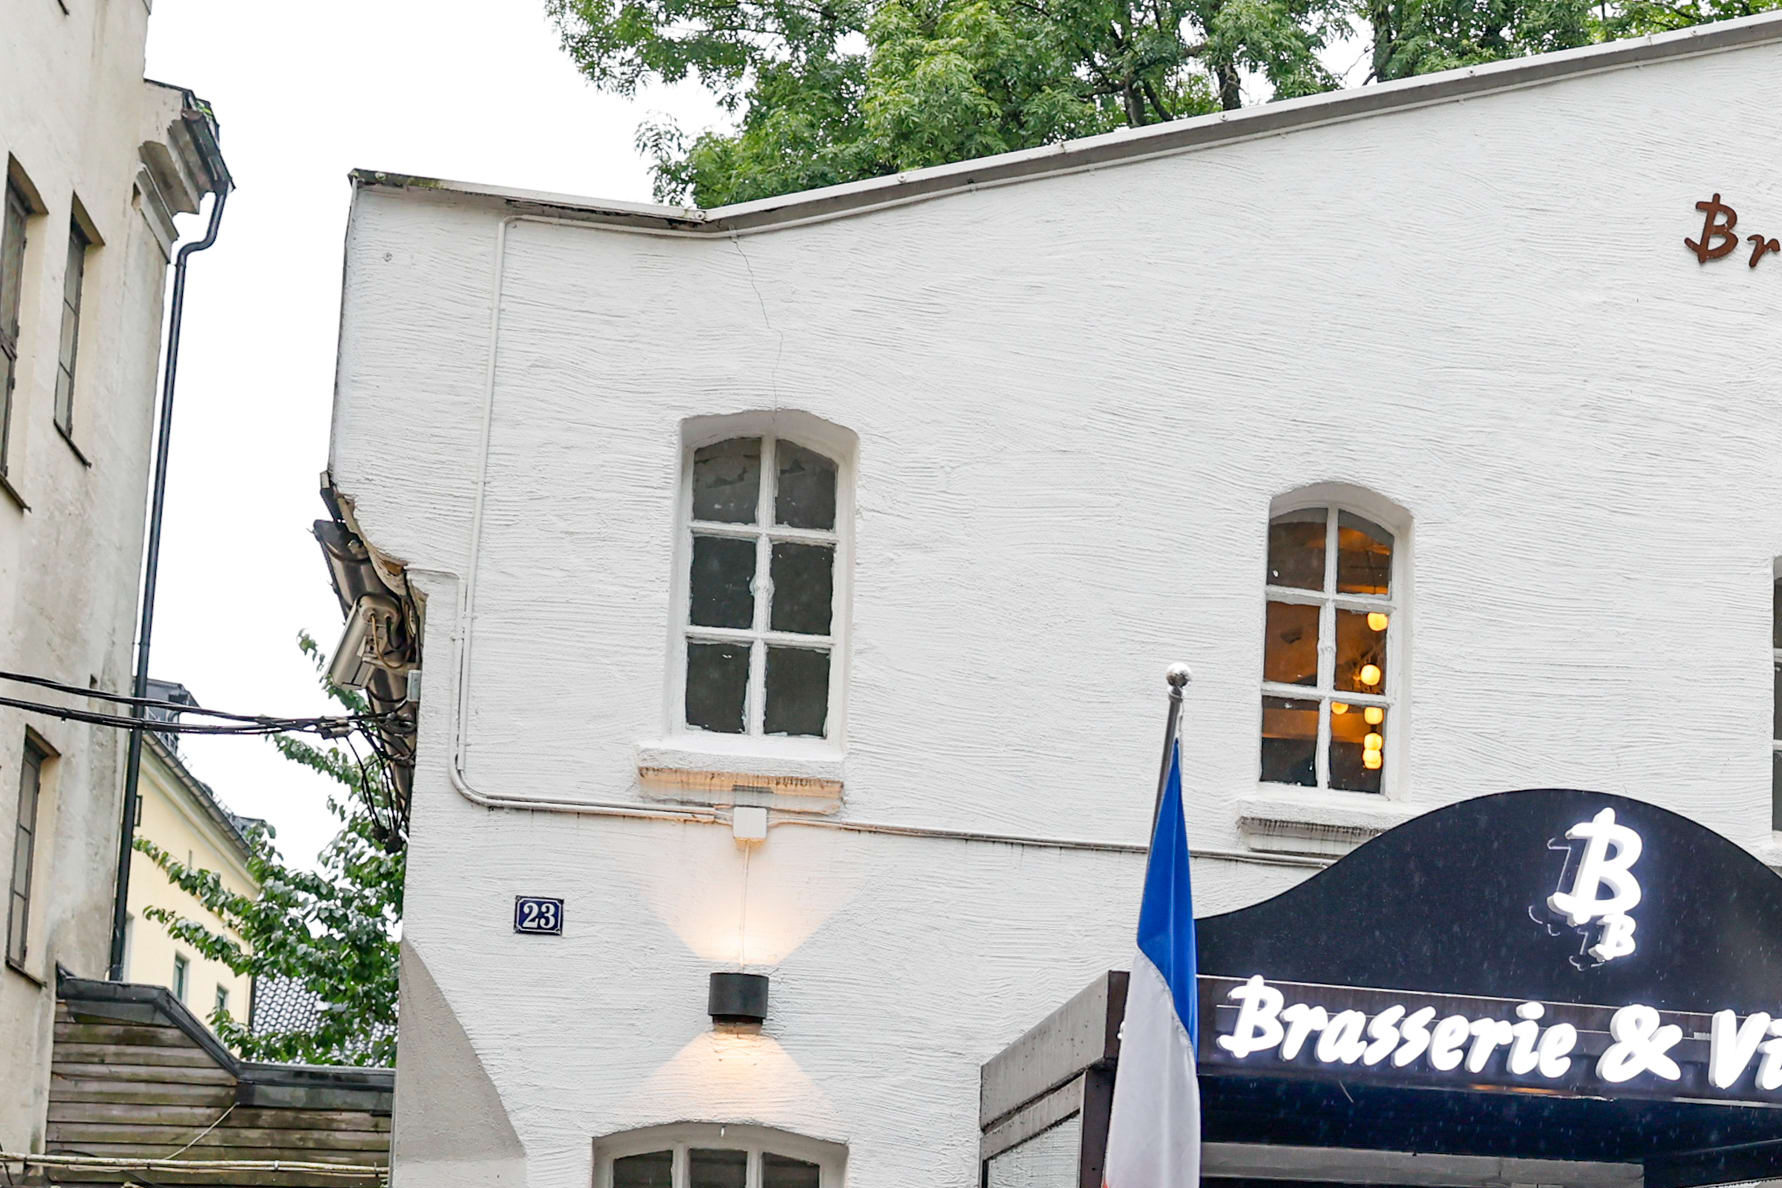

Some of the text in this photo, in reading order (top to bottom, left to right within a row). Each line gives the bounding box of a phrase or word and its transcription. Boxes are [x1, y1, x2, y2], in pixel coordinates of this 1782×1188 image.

[522, 902, 556, 929] 23
[1215, 975, 1579, 1079] Brasserie
[1596, 1004, 1684, 1083] &
